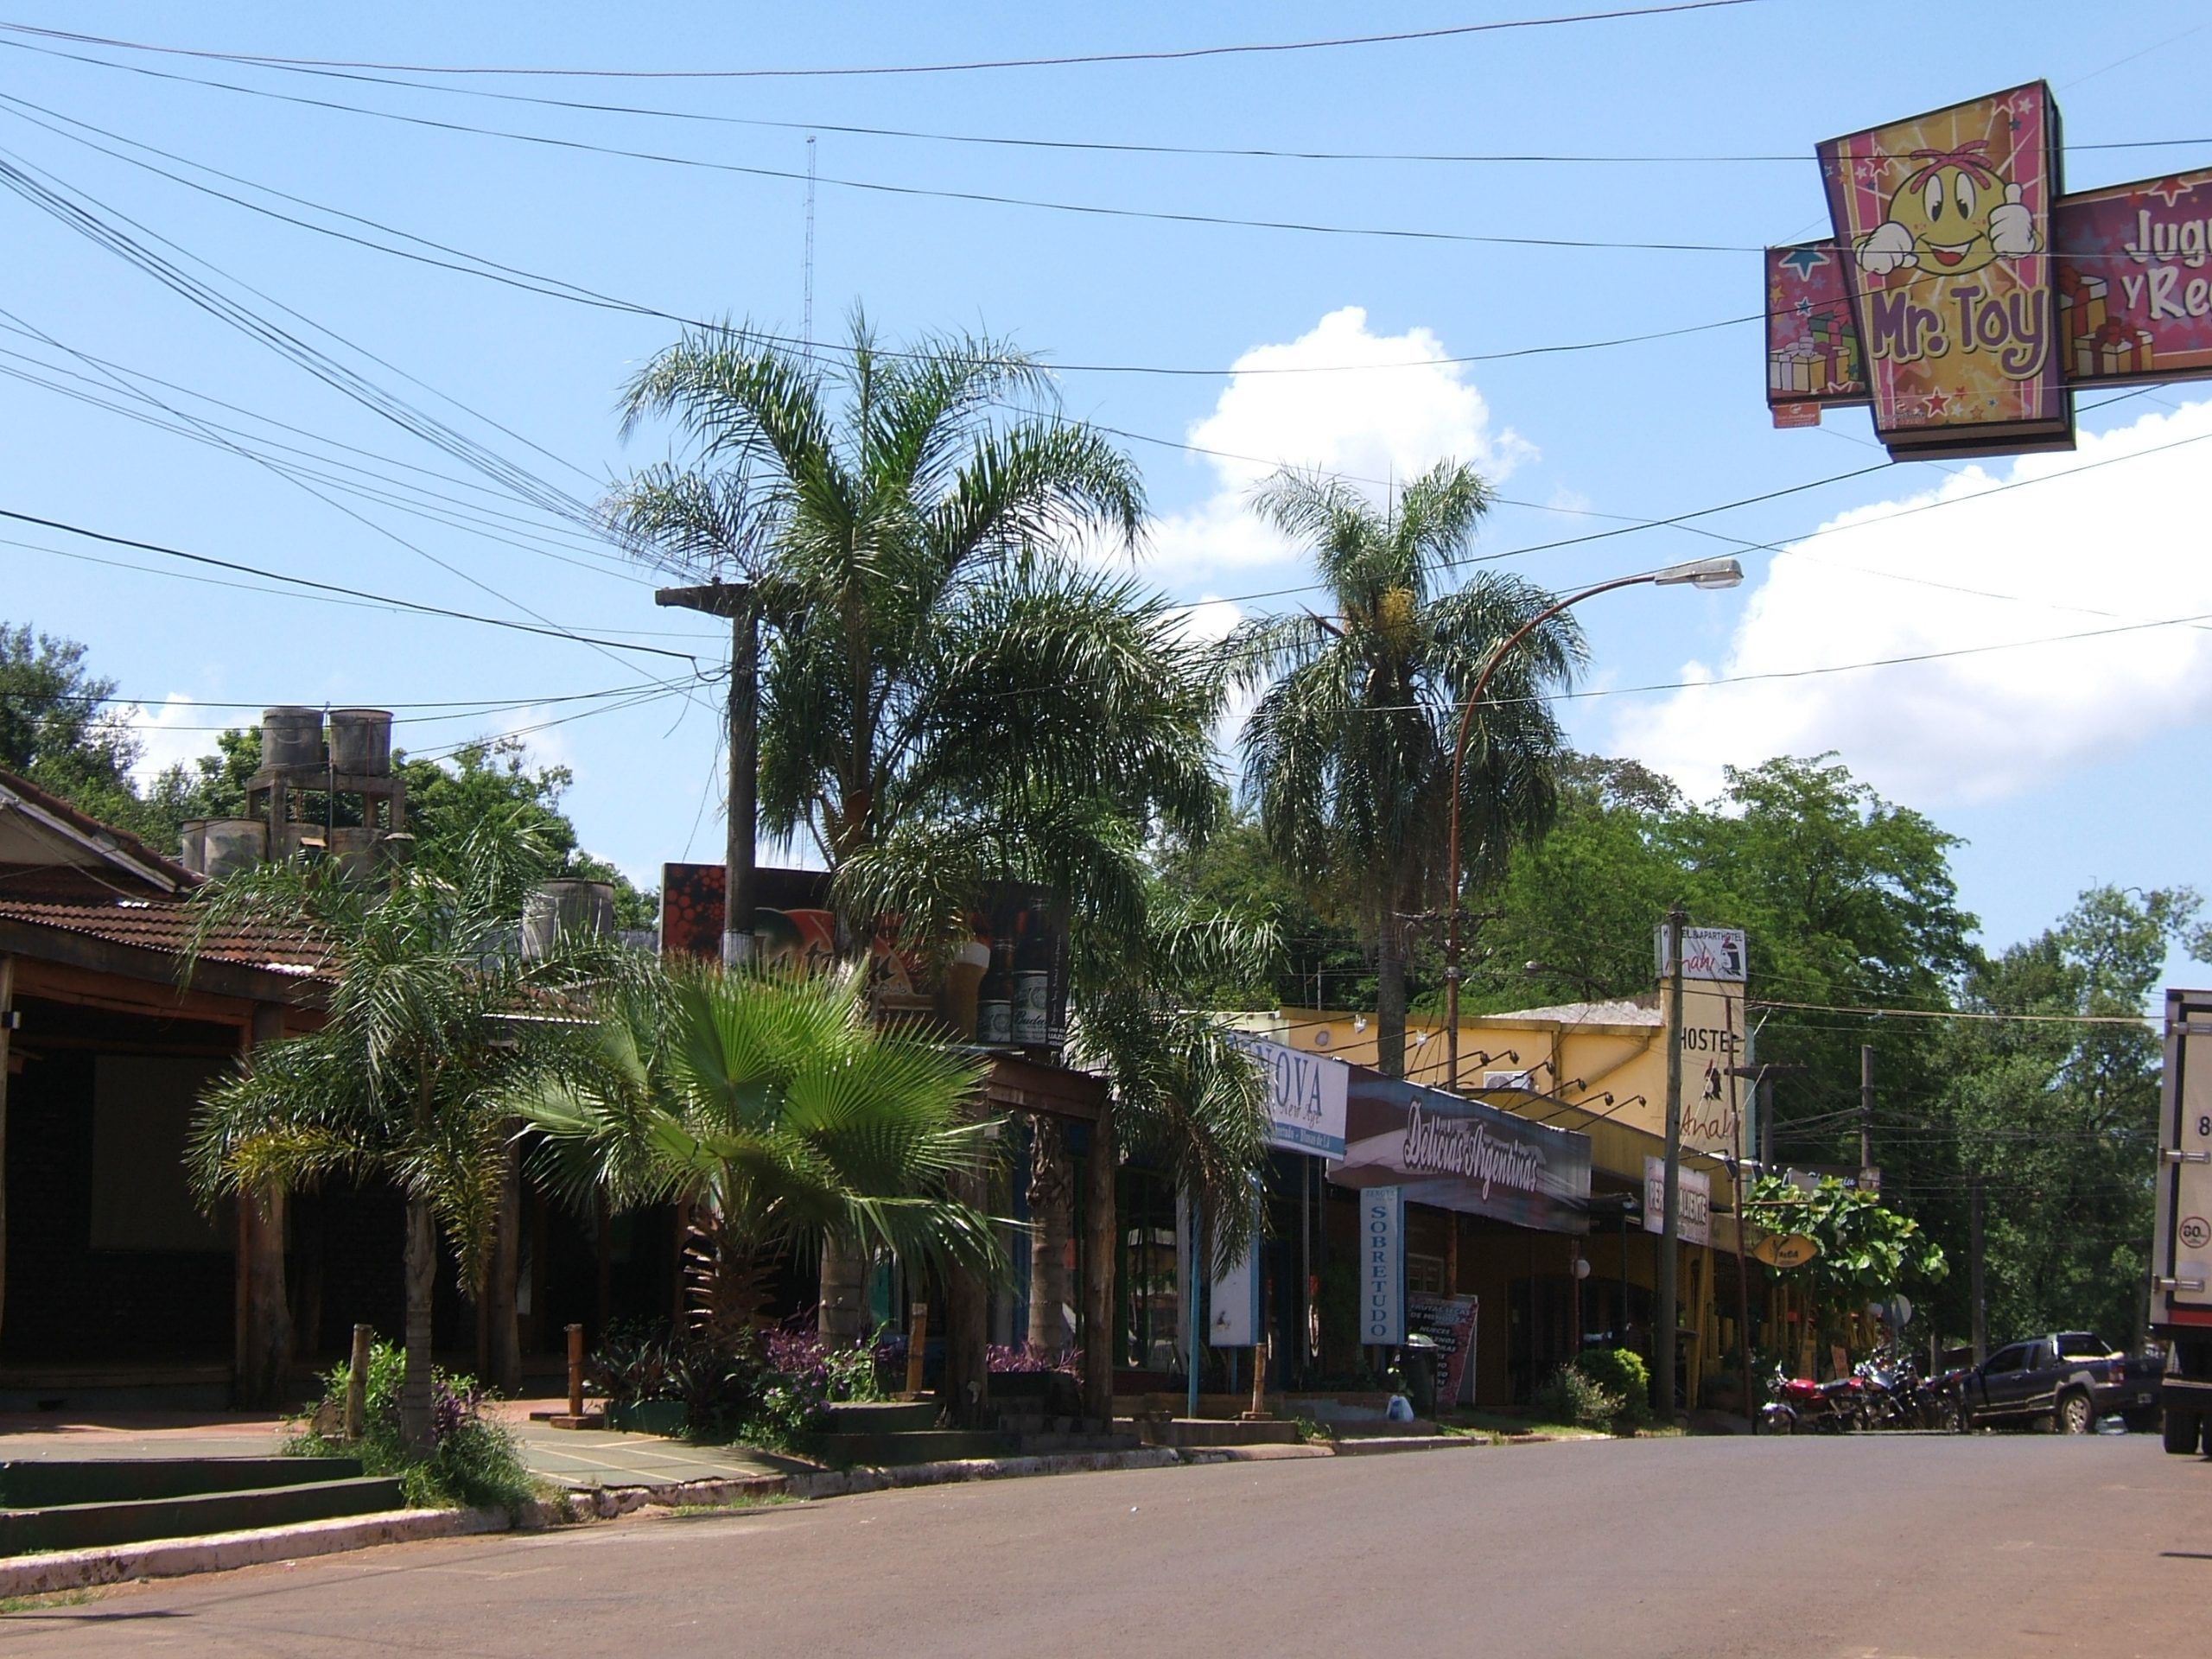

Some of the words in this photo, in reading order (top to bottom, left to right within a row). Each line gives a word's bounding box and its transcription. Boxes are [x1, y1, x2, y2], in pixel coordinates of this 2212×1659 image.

[2123, 208, 2212, 268] Jug
[2147, 264, 2212, 320] Re
[1870, 287, 1948, 362] Mr.
[1949, 284, 2050, 378] Toy
[1403, 1099, 1464, 1174] Delicias
[1464, 1124, 1537, 1201] Argentinas
[2199, 1116, 2212, 1136] 8
[1370, 1205, 1388, 1338] SOBRETUDO
